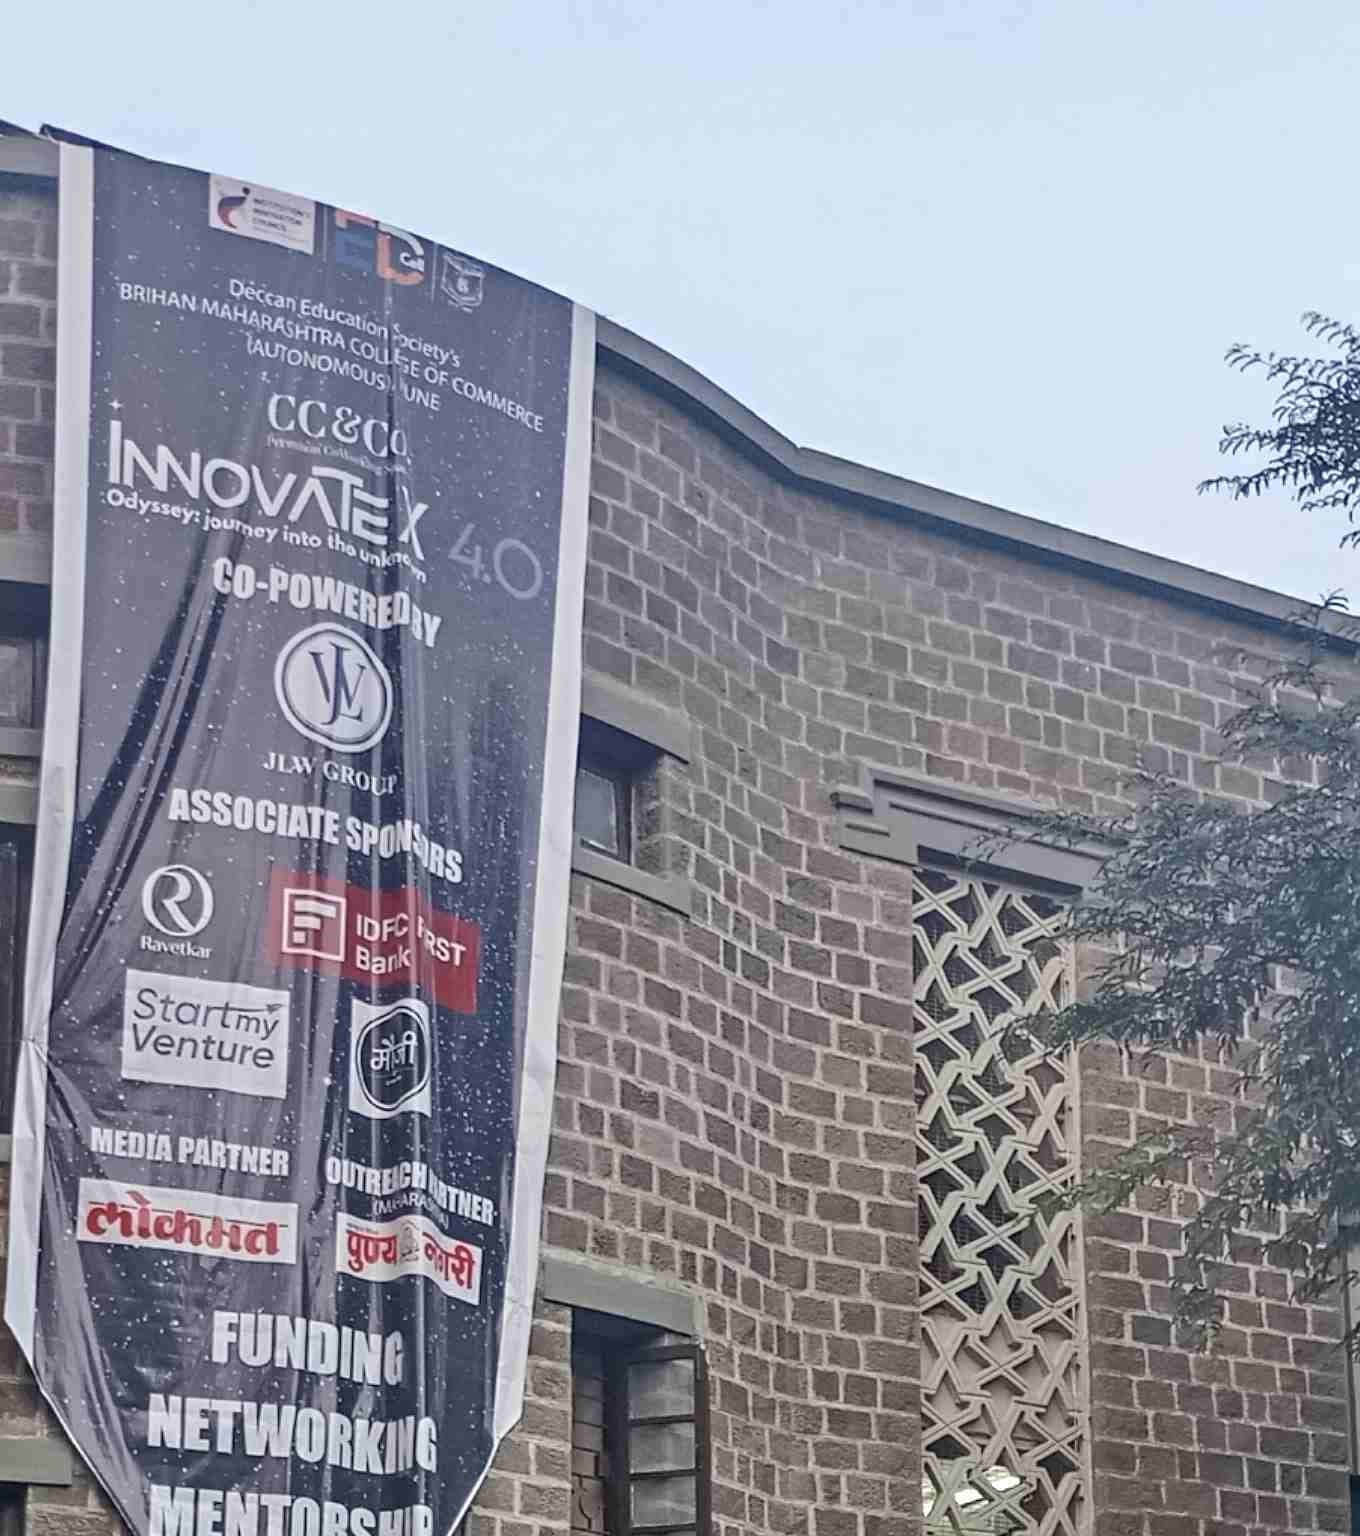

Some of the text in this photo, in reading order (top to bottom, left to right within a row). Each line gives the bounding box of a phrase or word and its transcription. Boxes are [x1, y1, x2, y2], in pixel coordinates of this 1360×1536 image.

[229, 278, 296, 312] Deccan
[300, 299, 389, 338] Education
[120, 282, 197, 312] BRIHAN
[201, 298, 345, 349] MAHARASHTRA
[424, 366, 448, 386] OF
[452, 377, 544, 432] COMMERCE
[399, 378, 440, 411] UNE
[106, 488, 200, 525] Odyssey:
[202, 508, 279, 543] journey
[282, 525, 323, 549] into
[327, 529, 357, 557] the
[448, 522, 543, 599] 4.0
[213, 557, 441, 648] CO-POWERED BY
[263, 752, 398, 797] JLW GROUP
[168, 788, 339, 844] ASSOCIATE
[141, 935, 212, 958] Ravetkar
[356, 912, 467, 966] IDFC FRST
[356, 945, 413, 975] Bank
[132, 1023, 275, 1069] Venture
[90, 1126, 290, 1176] MEDIA PARTNER
[212, 1310, 404, 1386] FUNDING
[147, 1393, 438, 1475] NETWORKING
